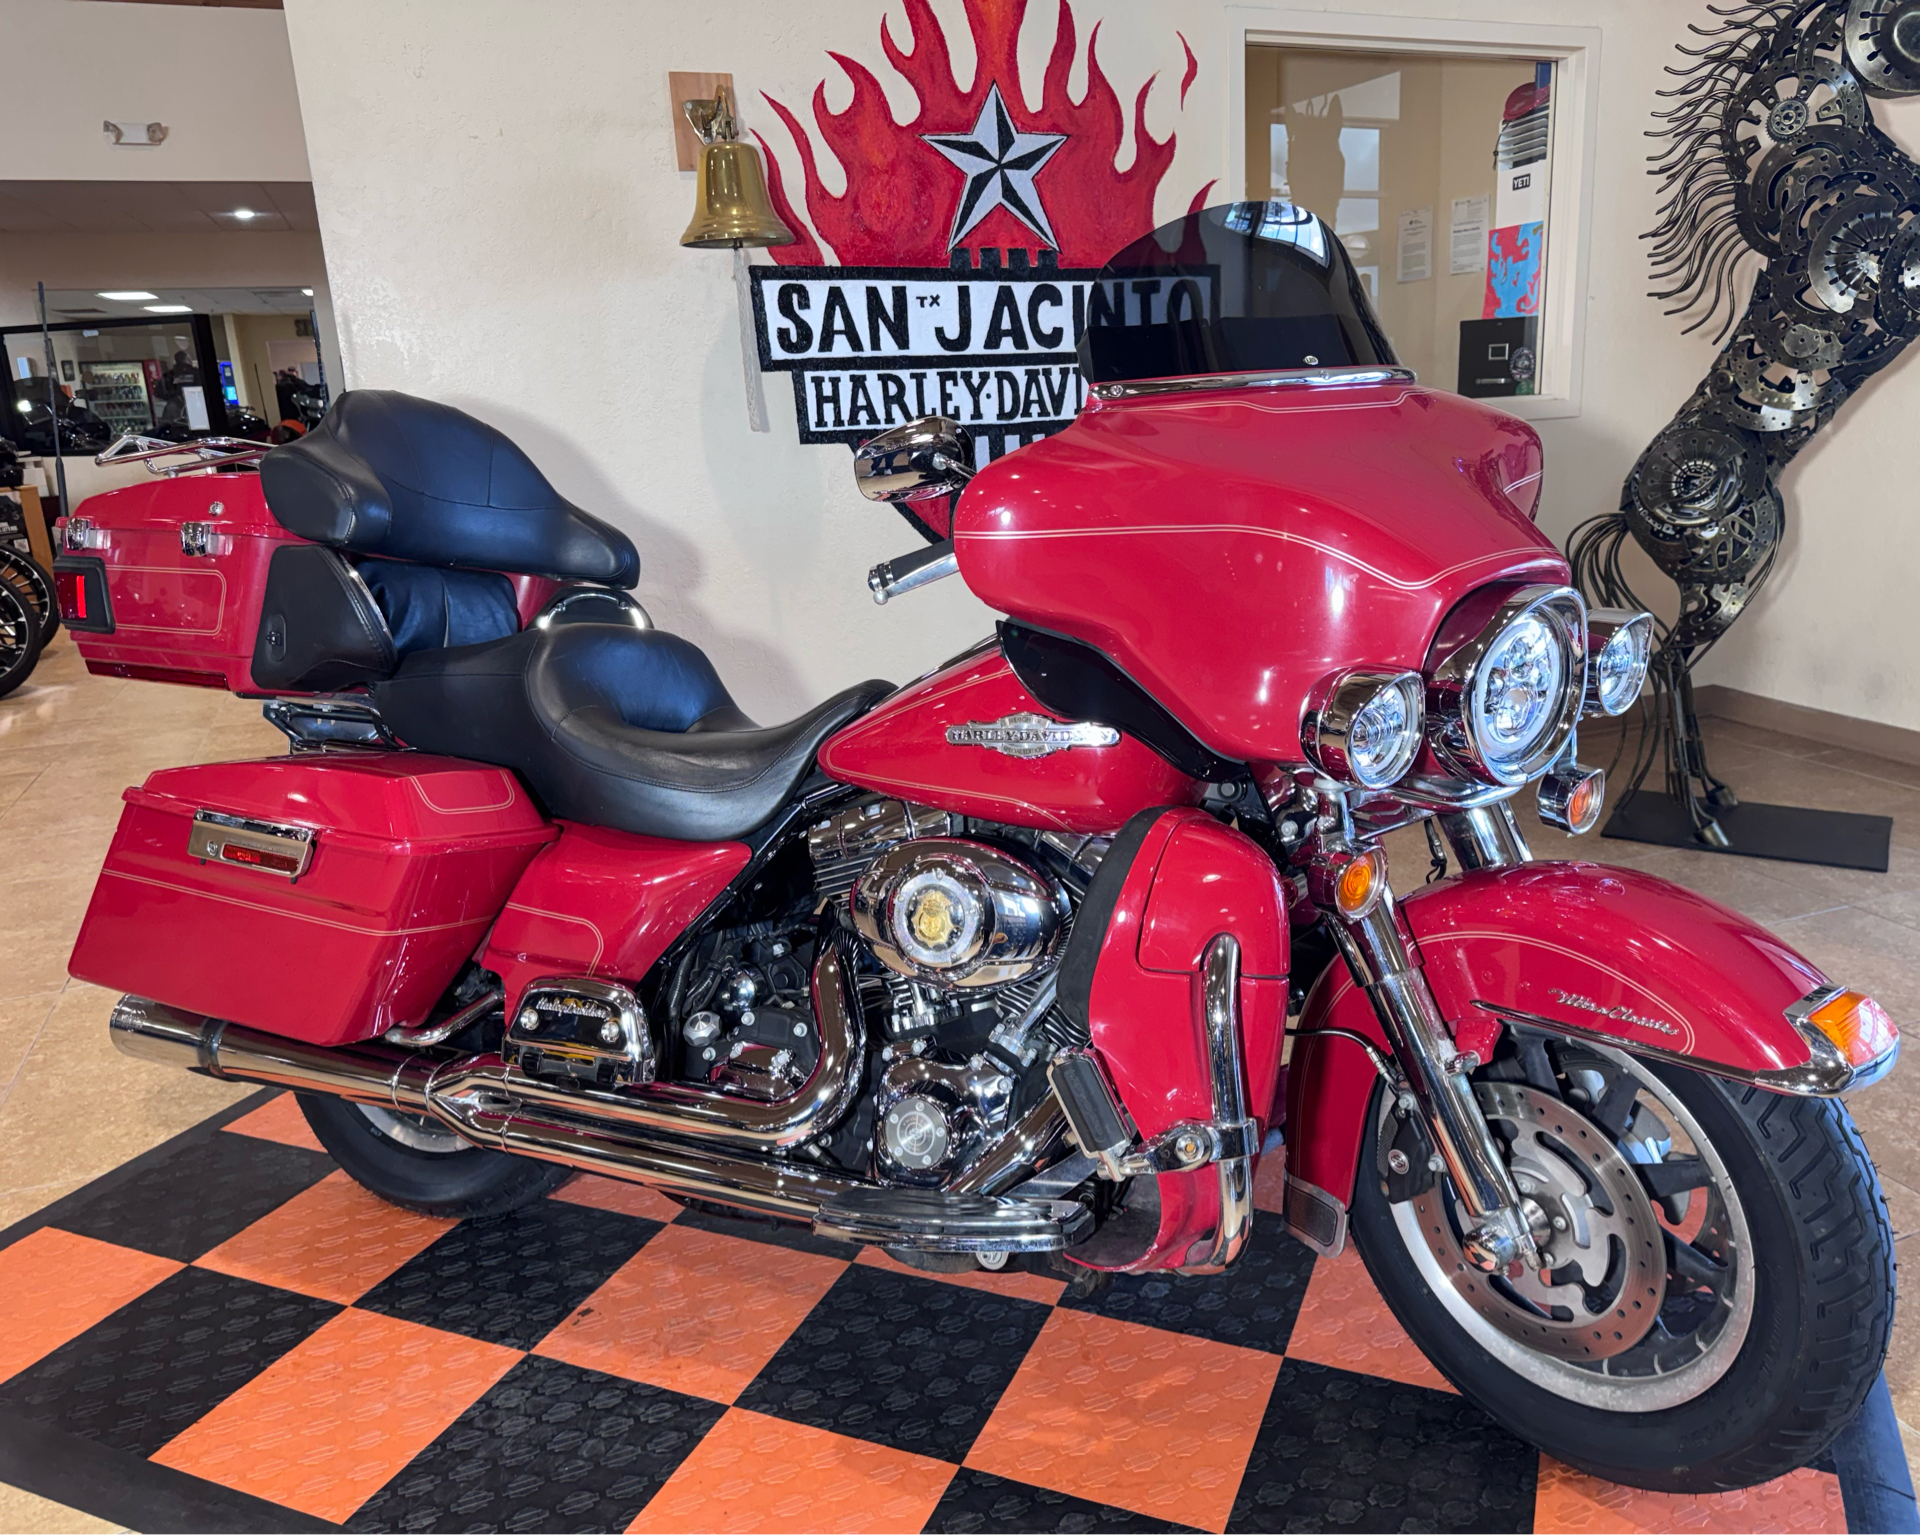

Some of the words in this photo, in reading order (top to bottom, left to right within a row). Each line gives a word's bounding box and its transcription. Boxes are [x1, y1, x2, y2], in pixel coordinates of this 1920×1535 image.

[1513, 176, 1530, 189] YETI
[776, 282, 911, 354] SAN
[916, 294, 941, 308] TX
[810, 366, 1084, 428] HARLEY·DAVI
[1608, 1006, 1679, 1035] Classic
